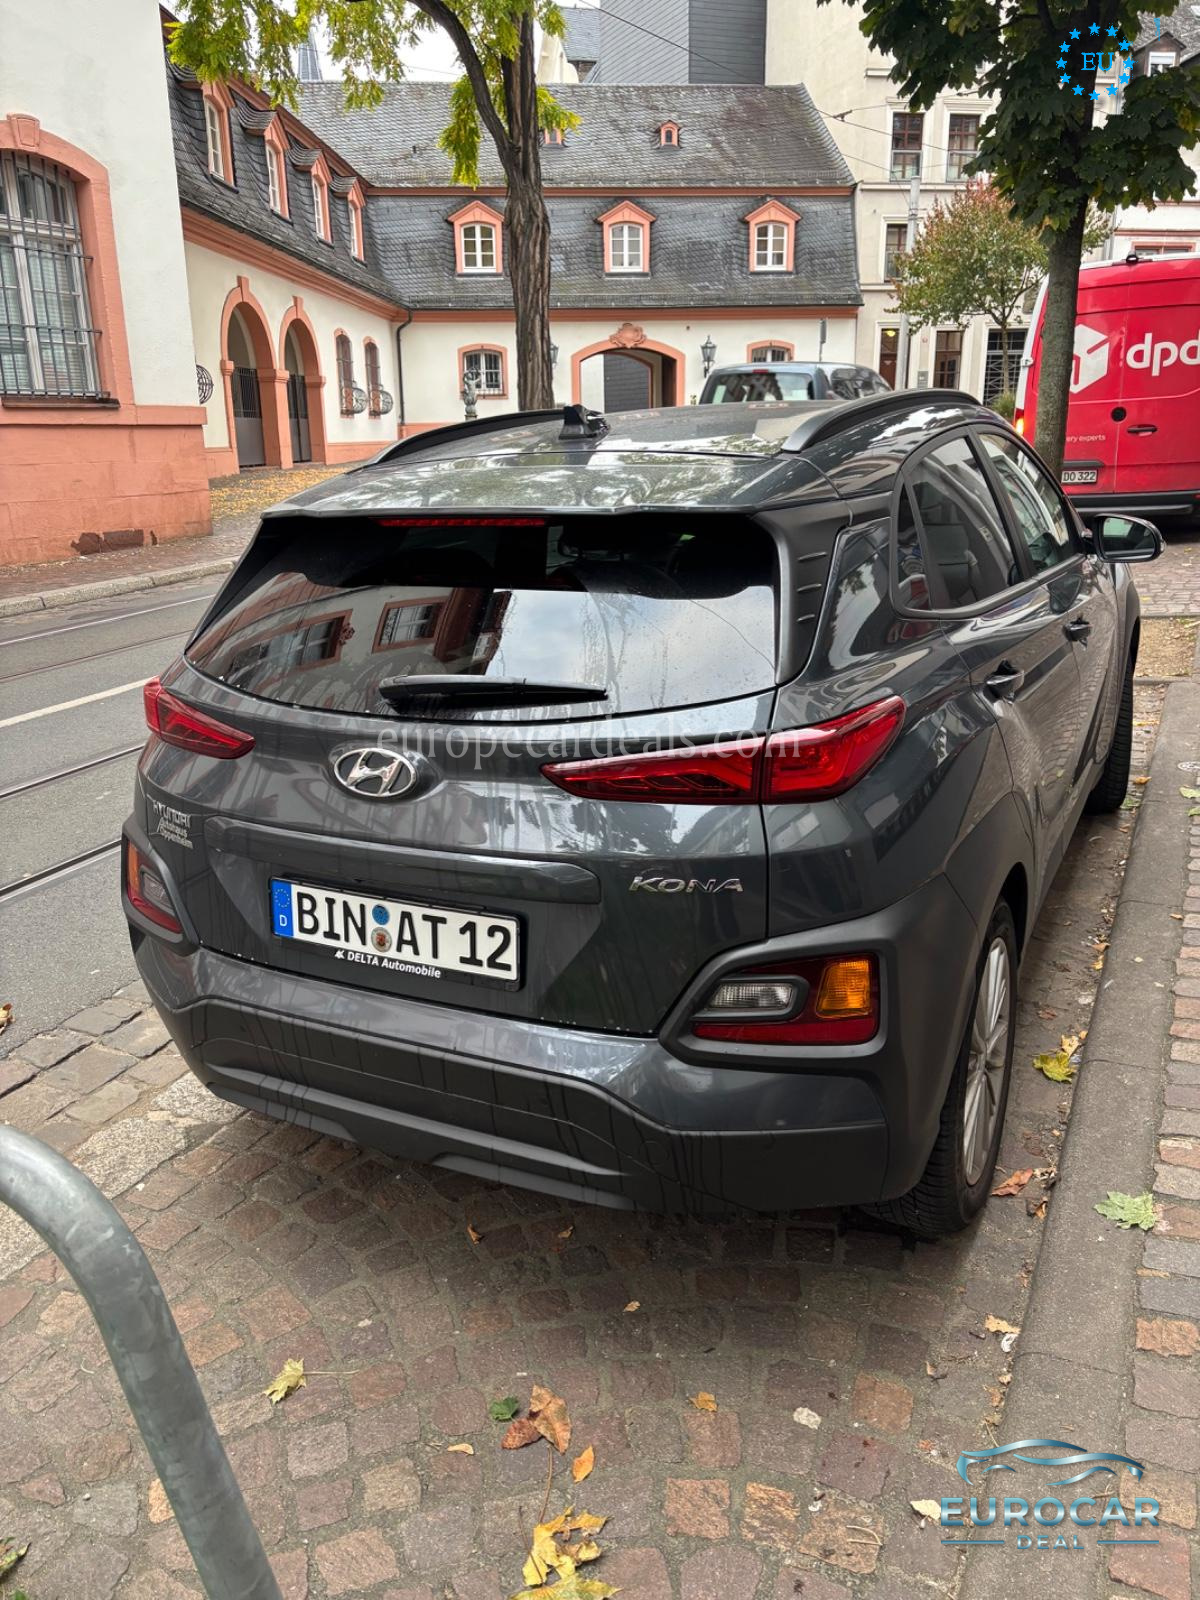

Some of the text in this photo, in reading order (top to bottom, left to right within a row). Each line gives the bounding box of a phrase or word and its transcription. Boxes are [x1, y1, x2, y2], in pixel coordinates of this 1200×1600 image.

[1126, 329, 1200, 376] dpd
[1079, 434, 1106, 443] experts
[1063, 471, 1096, 481] DO 322
[152, 799, 191, 829] HYUNDAI
[628, 875, 745, 894] KONA
[279, 914, 288, 927] D
[296, 891, 512, 972] BIN AT 12
[347, 950, 442, 979] DELTA Automobile
